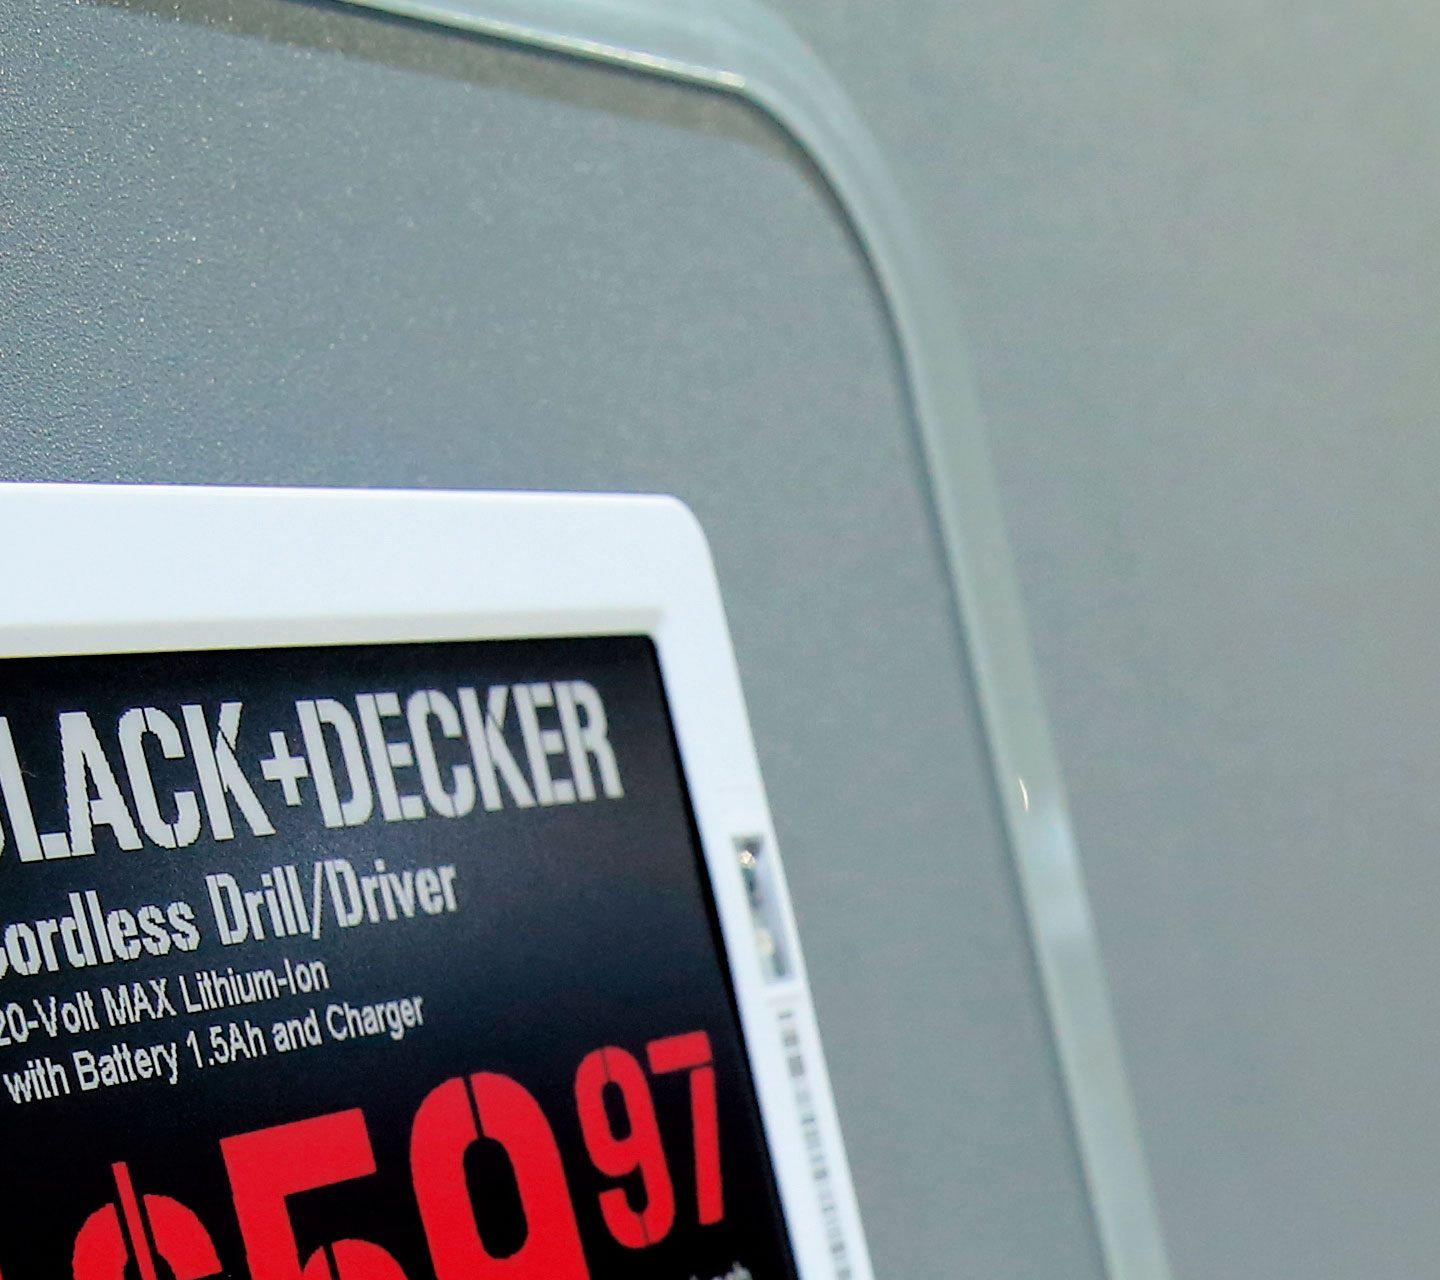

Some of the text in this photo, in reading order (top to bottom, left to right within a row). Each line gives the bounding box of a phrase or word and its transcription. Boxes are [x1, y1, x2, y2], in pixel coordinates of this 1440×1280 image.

[204, 858, 458, 945] Drill/Driver
[103, 977, 176, 1028] MAX
[178, 957, 331, 1014] Lithium-Ion
[2, 996, 425, 1105] with Battery 1.5Ah and Charger
